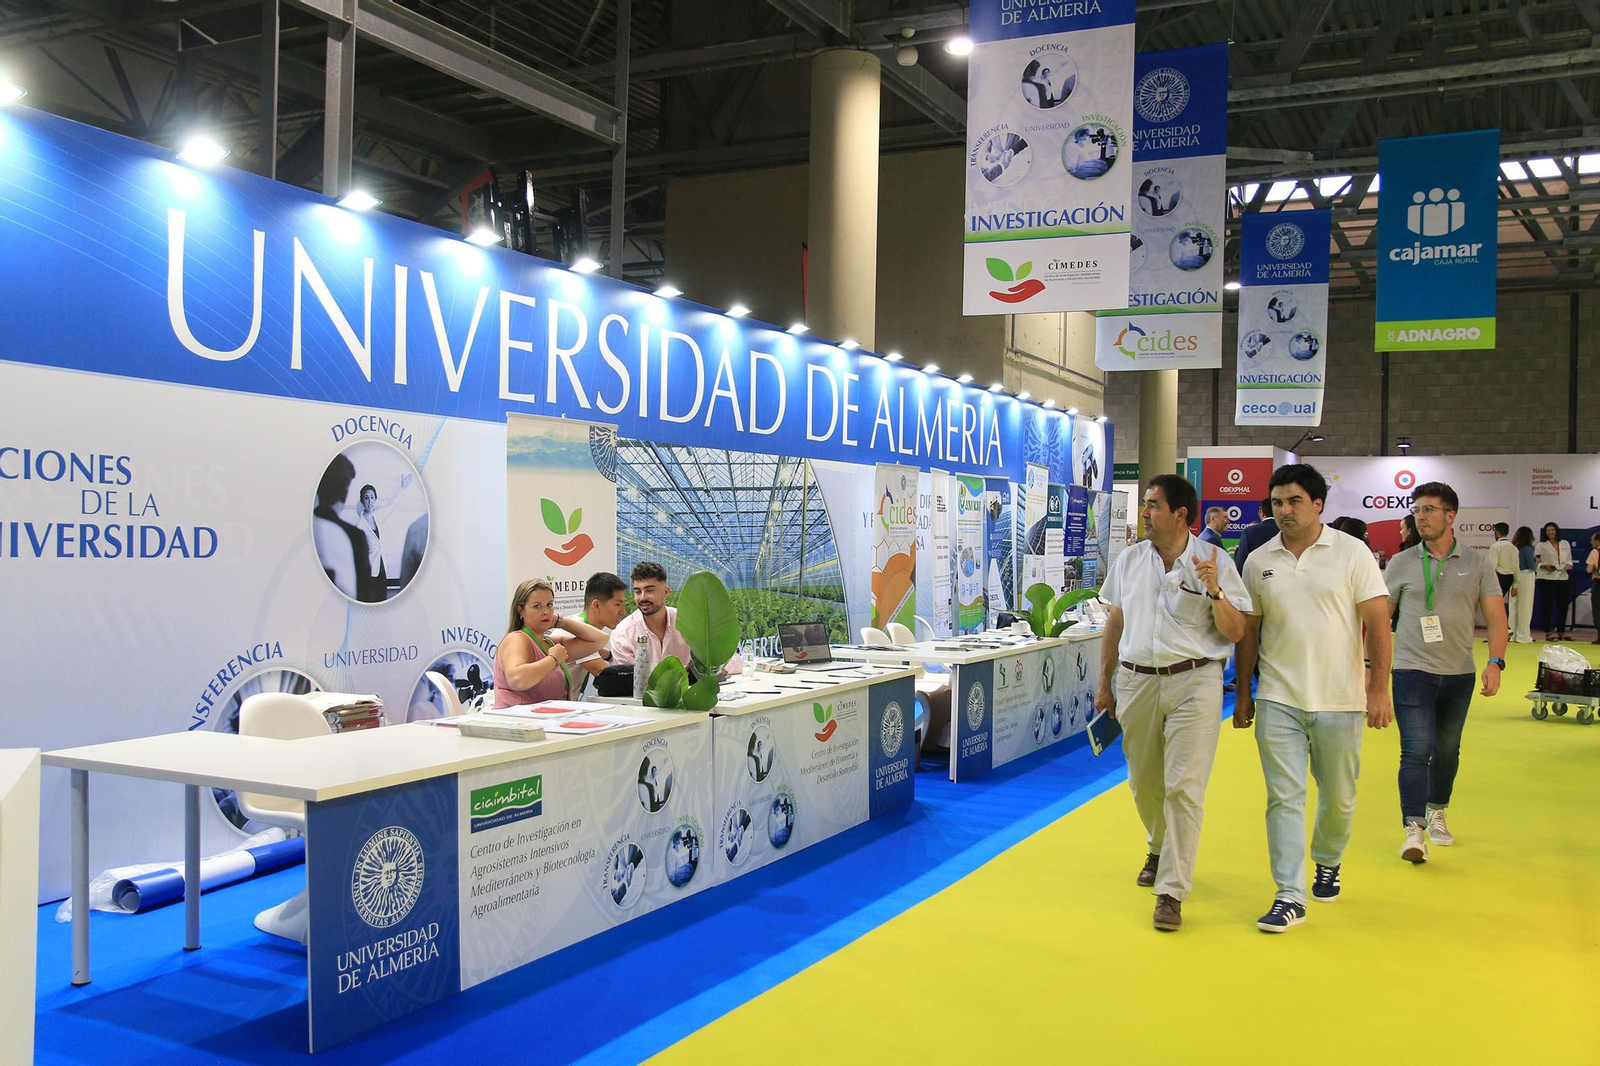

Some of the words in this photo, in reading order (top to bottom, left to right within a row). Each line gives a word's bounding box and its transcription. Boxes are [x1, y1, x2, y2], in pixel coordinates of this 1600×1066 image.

[1001, 11, 1022, 25] DE
[1029, 43, 1069, 57] DOCENCIA
[1024, 122, 1070, 132] UNIVERSIDAD
[1082, 114, 1127, 147] INVESTIGACIÓN
[1133, 124, 1201, 140] NIVERSIDAD
[970, 123, 1009, 167] TRANSFERENCIA
[972, 202, 1125, 232] INVESTIGACIÓN
[1389, 241, 1483, 265] cajamar
[1455, 257, 1479, 265] RURAL
[1256, 262, 1312, 271] UNIVERSIDAD
[1256, 271, 1269, 279] DE
[1129, 287, 1218, 307] ESTIGACIÓN
[167, 206, 786, 435] UNIVERSIDAD
[806, 364, 858, 446] DE
[1396, 326, 1481, 343] ADNAGRO
[1137, 329, 1198, 352] cides
[1239, 371, 1322, 384] INVESTIGACIÓN
[331, 415, 413, 450] DOCENCIA
[81, 489, 118, 515] DE
[128, 492, 160, 517] LA
[1362, 495, 1414, 509] COEXP
[0, 521, 218, 559] IVERSIDAD
[554, 580, 585, 592] MEDE
[441, 626, 498, 660] INVESTIG
[324, 645, 419, 669] UNIVERSIDAD
[187, 641, 284, 731] NSFERENCIA
[642, 737, 669, 753] DOCENCIA
[811, 746, 827, 760] Centro
[962, 748, 969, 759] DE
[875, 758, 909, 779] UNIVERSIDAD
[474, 779, 541, 811] ciaimbital
[875, 778, 884, 791] DE
[474, 816, 506, 828] UNIVERSIDAD
[355, 860, 363, 873] IN
[360, 830, 388, 859] LUMINE
[389, 828, 420, 857] SAPIENTIA
[470, 841, 501, 859] Centro
[503, 835, 515, 850] de
[517, 820, 570, 846] Investigación
[571, 818, 582, 829] en
[469, 852, 528, 880] Agrosistemas
[530, 839, 570, 861] Intensivos
[602, 833, 631, 890] TRANSFERENCIA
[470, 871, 533, 899] Mediterráneos
[535, 868, 541, 880] y
[543, 847, 596, 875] Biotecnología
[353, 882, 389, 926] UNIVERSITAS
[391, 862, 423, 924] ALMERIENSIS
[470, 884, 540, 919] Agroalimentaria
[337, 922, 440, 972] UNIVERSIDAD
[338, 969, 362, 994] DE
[366, 941, 440, 983] ALMERÍA
